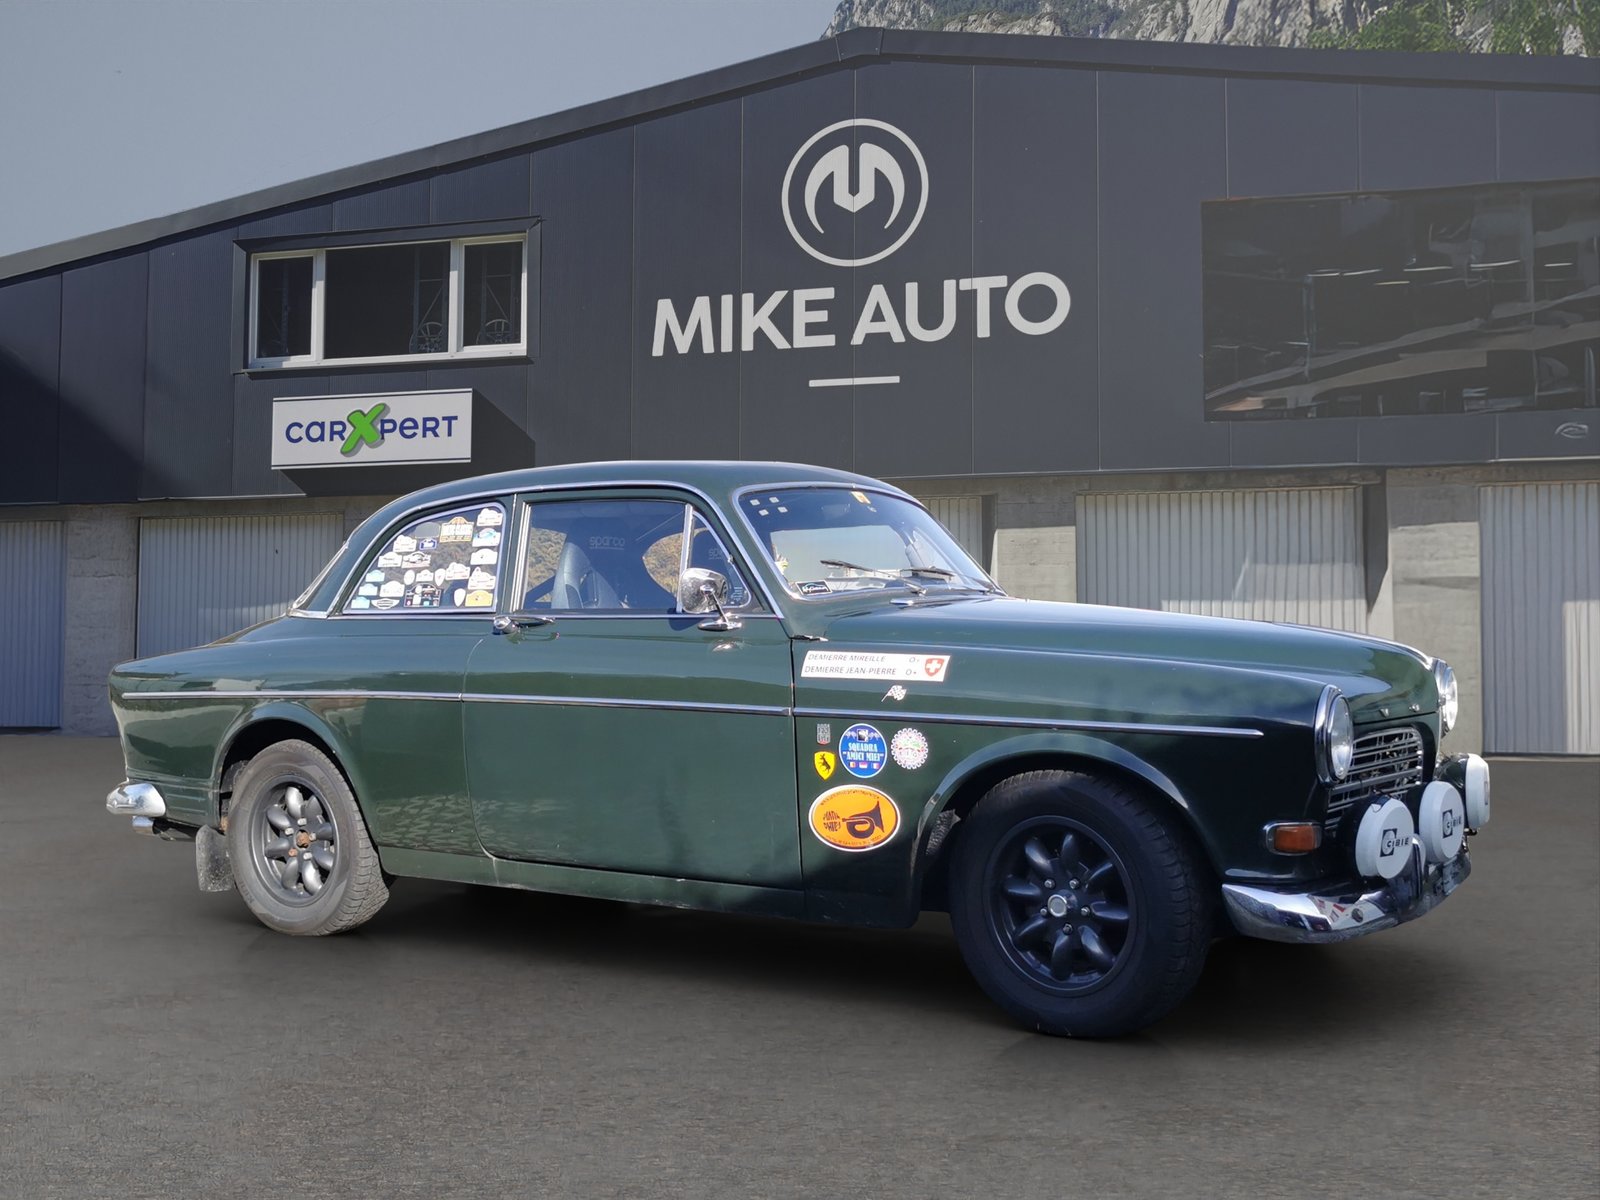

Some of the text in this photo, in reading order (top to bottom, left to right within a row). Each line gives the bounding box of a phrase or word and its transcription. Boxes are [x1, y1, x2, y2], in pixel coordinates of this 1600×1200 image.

[652, 271, 1071, 357] MIKE AUTO
[589, 536, 625, 548] sparco
[808, 654, 847, 662] DEMIERRE
[849, 655, 886, 663] MIREILLE
[804, 665, 844, 674] DEMIERRE
[845, 667, 897, 675] JEAN-PIERRE
[848, 742, 878, 752] SQUADRA
[1446, 817, 1462, 829] CIBIE
[1386, 837, 1409, 848] CIBIE
